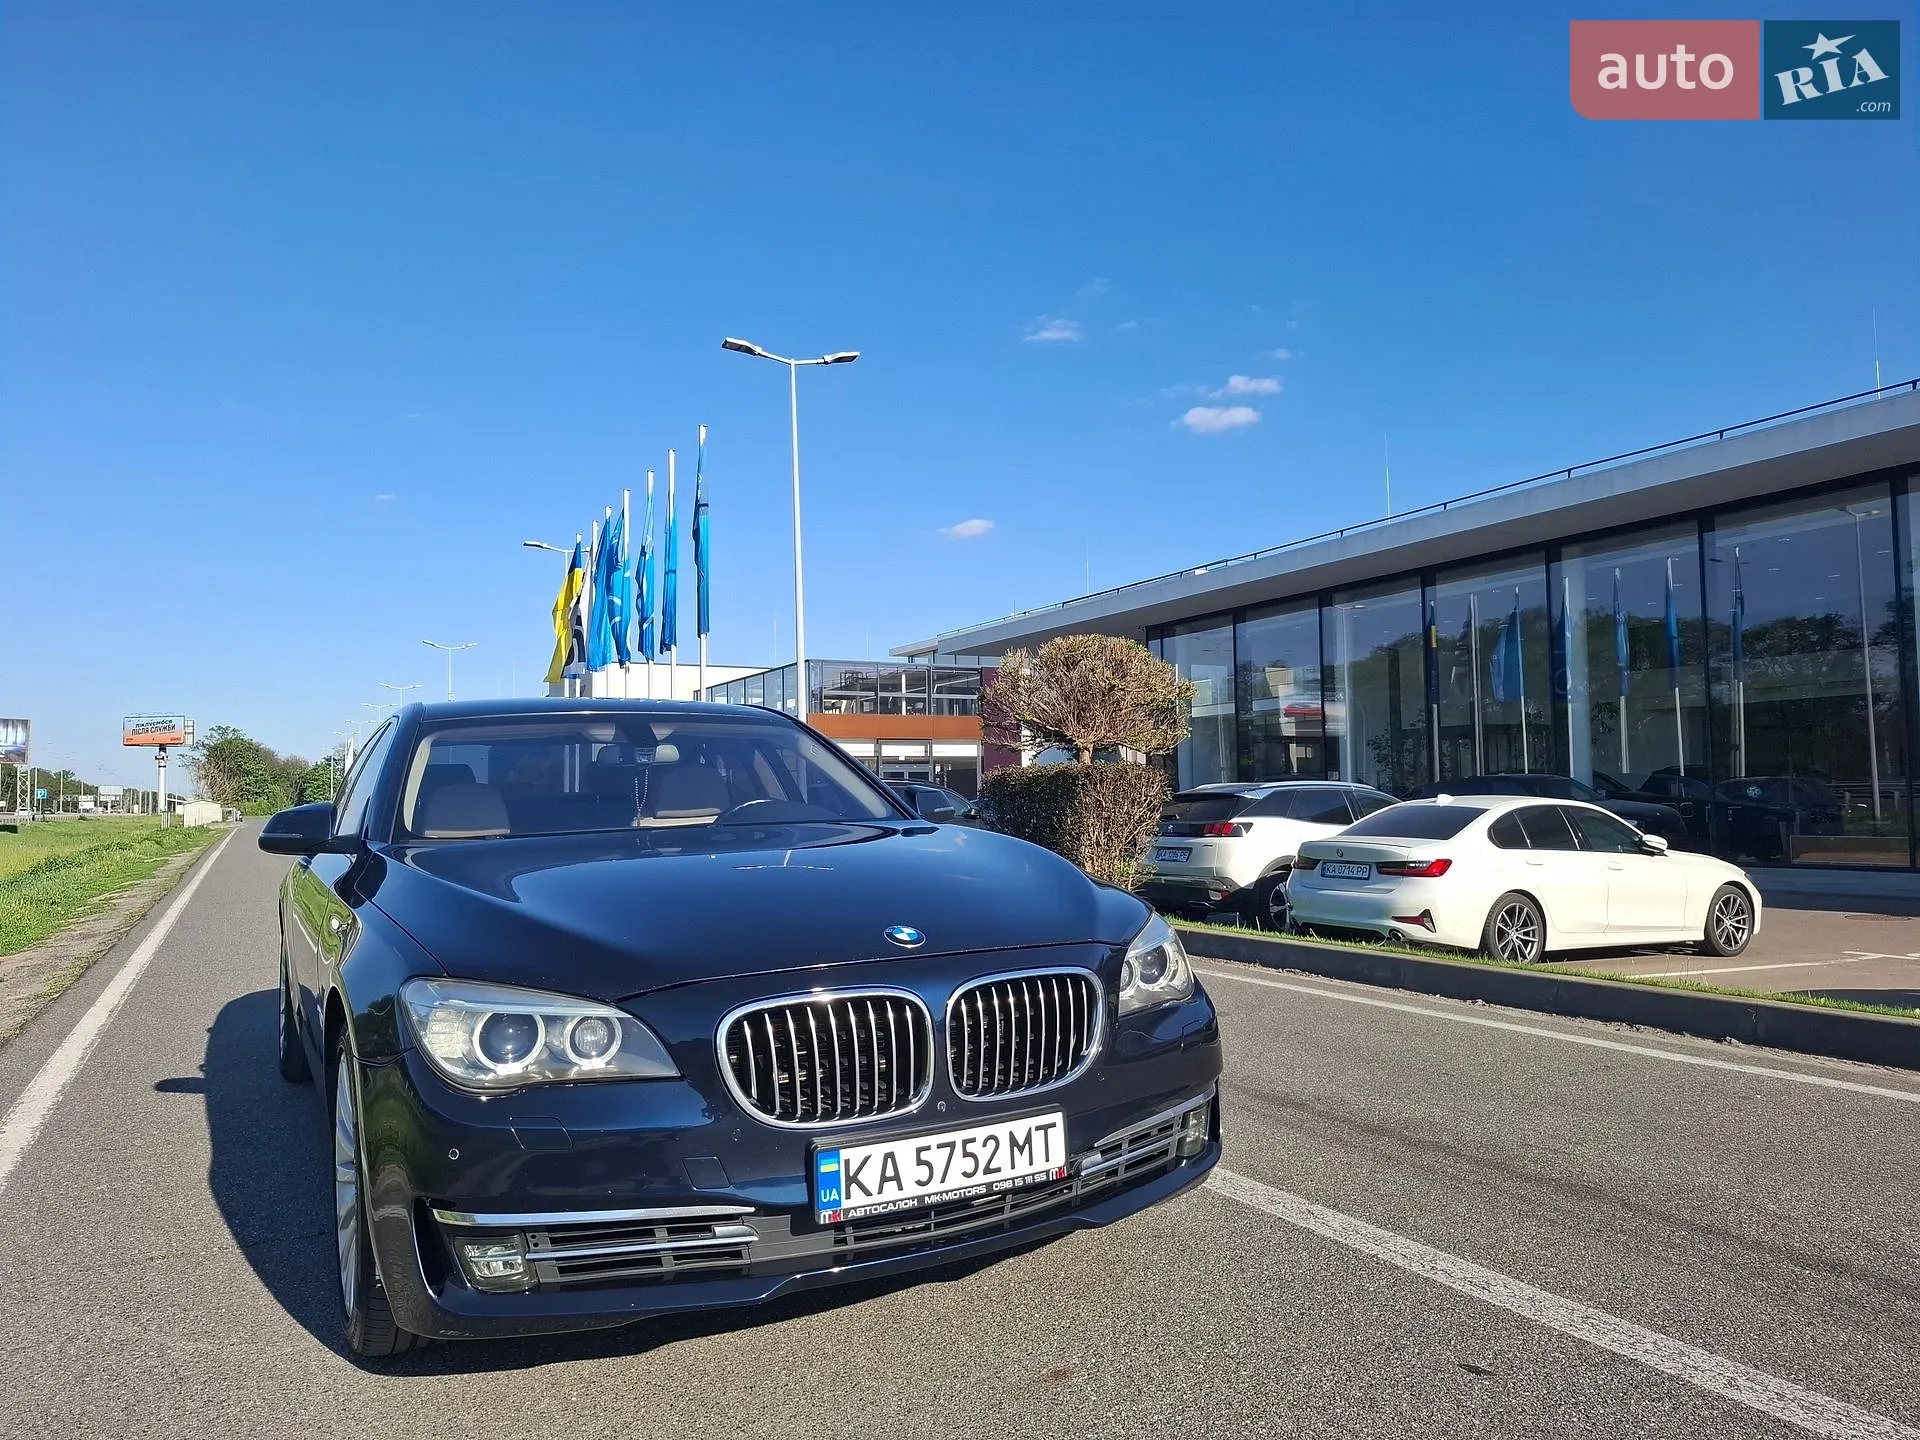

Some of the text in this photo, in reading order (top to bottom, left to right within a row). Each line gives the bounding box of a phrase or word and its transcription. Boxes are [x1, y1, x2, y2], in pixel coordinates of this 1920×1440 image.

[150, 724, 175, 733] СЛУЖБИ
[1326, 863, 1336, 875] KA
[1338, 864, 1355, 876] 0714
[844, 1122, 1057, 1200] KA 5752 MT
[820, 1188, 840, 1203] UA
[924, 1185, 987, 1205] MK-MOTORS
[992, 1179, 1013, 1191] 098
[848, 1198, 918, 1218] АВТОСАЛОН
